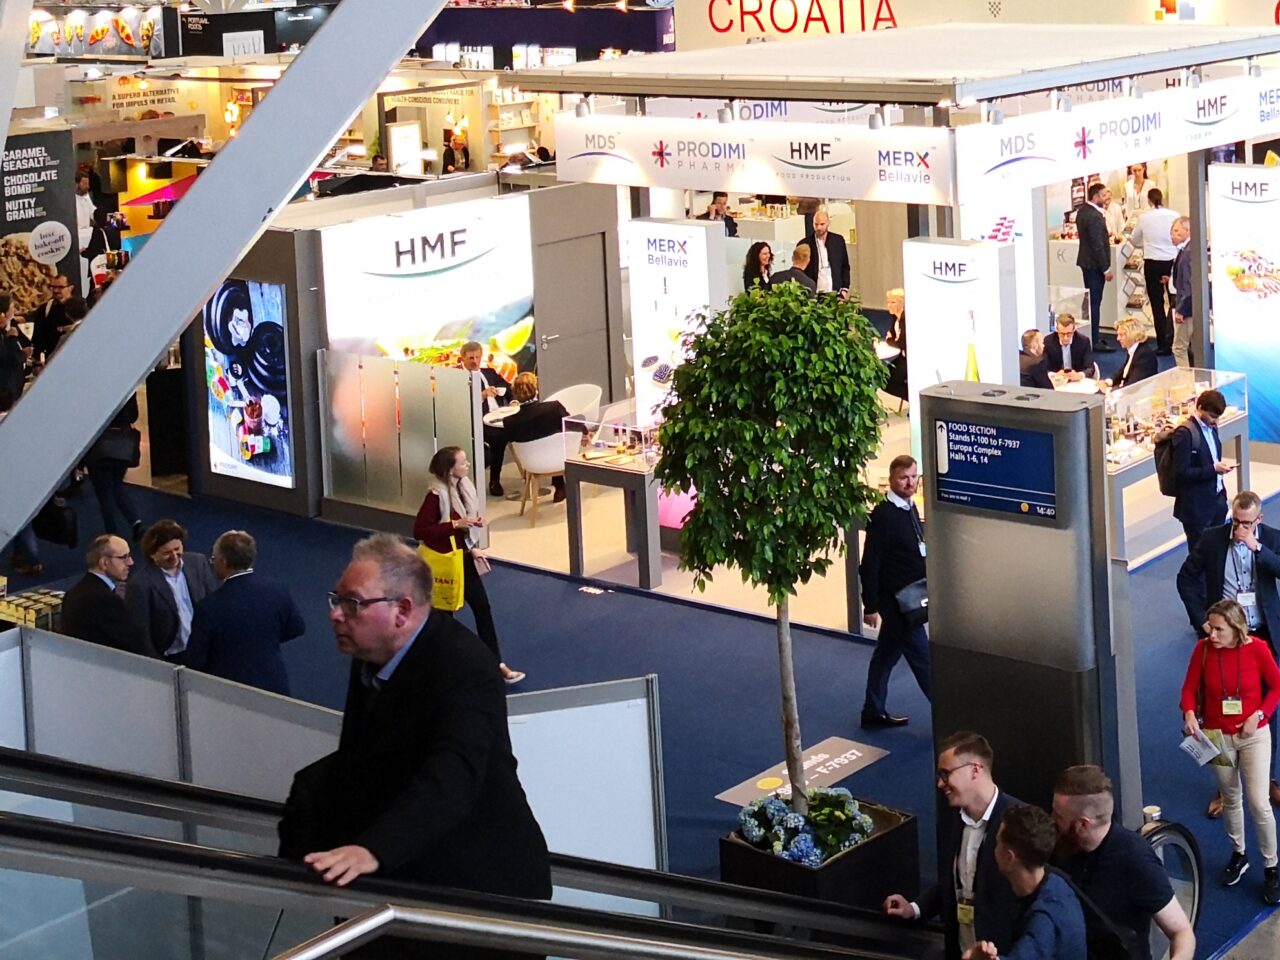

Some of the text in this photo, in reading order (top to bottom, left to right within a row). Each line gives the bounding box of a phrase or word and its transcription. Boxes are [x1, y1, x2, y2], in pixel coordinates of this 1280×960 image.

[739, 101, 787, 121] ODIMI
[1196, 95, 1227, 119] HMF
[1099, 112, 1162, 139] PRODIMI
[585, 134, 616, 150] MDS
[677, 140, 746, 159] PRODIMI
[1000, 133, 1036, 157] MDS
[3, 146, 48, 161] CARAMEL
[790, 141, 831, 161] HMF
[3, 156, 44, 172] SEASALT
[677, 160, 745, 172] PHARM
[878, 150, 930, 169] MERX
[3, 170, 58, 186] CHOCOLATE
[879, 170, 931, 185] Bellavie
[4, 184, 32, 197] BOMB
[1231, 181, 1270, 198] HMF
[5, 197, 36, 211] NUTTY
[6, 208, 35, 221] GRAIN
[394, 228, 467, 268] HMF
[647, 237, 687, 255] MERX
[648, 254, 688, 268] Bellavie
[933, 261, 966, 277] HMF
[948, 422, 996, 436] FOOD SECTION
[948, 432, 1020, 449] Stands F-100 to F-7937
[949, 442, 1002, 456] Europa Complex
[949, 451, 988, 464] Halls 1-6, 14
[1036, 506, 1056, 516] 14:40
[815, 749, 863, 775] F-7937
